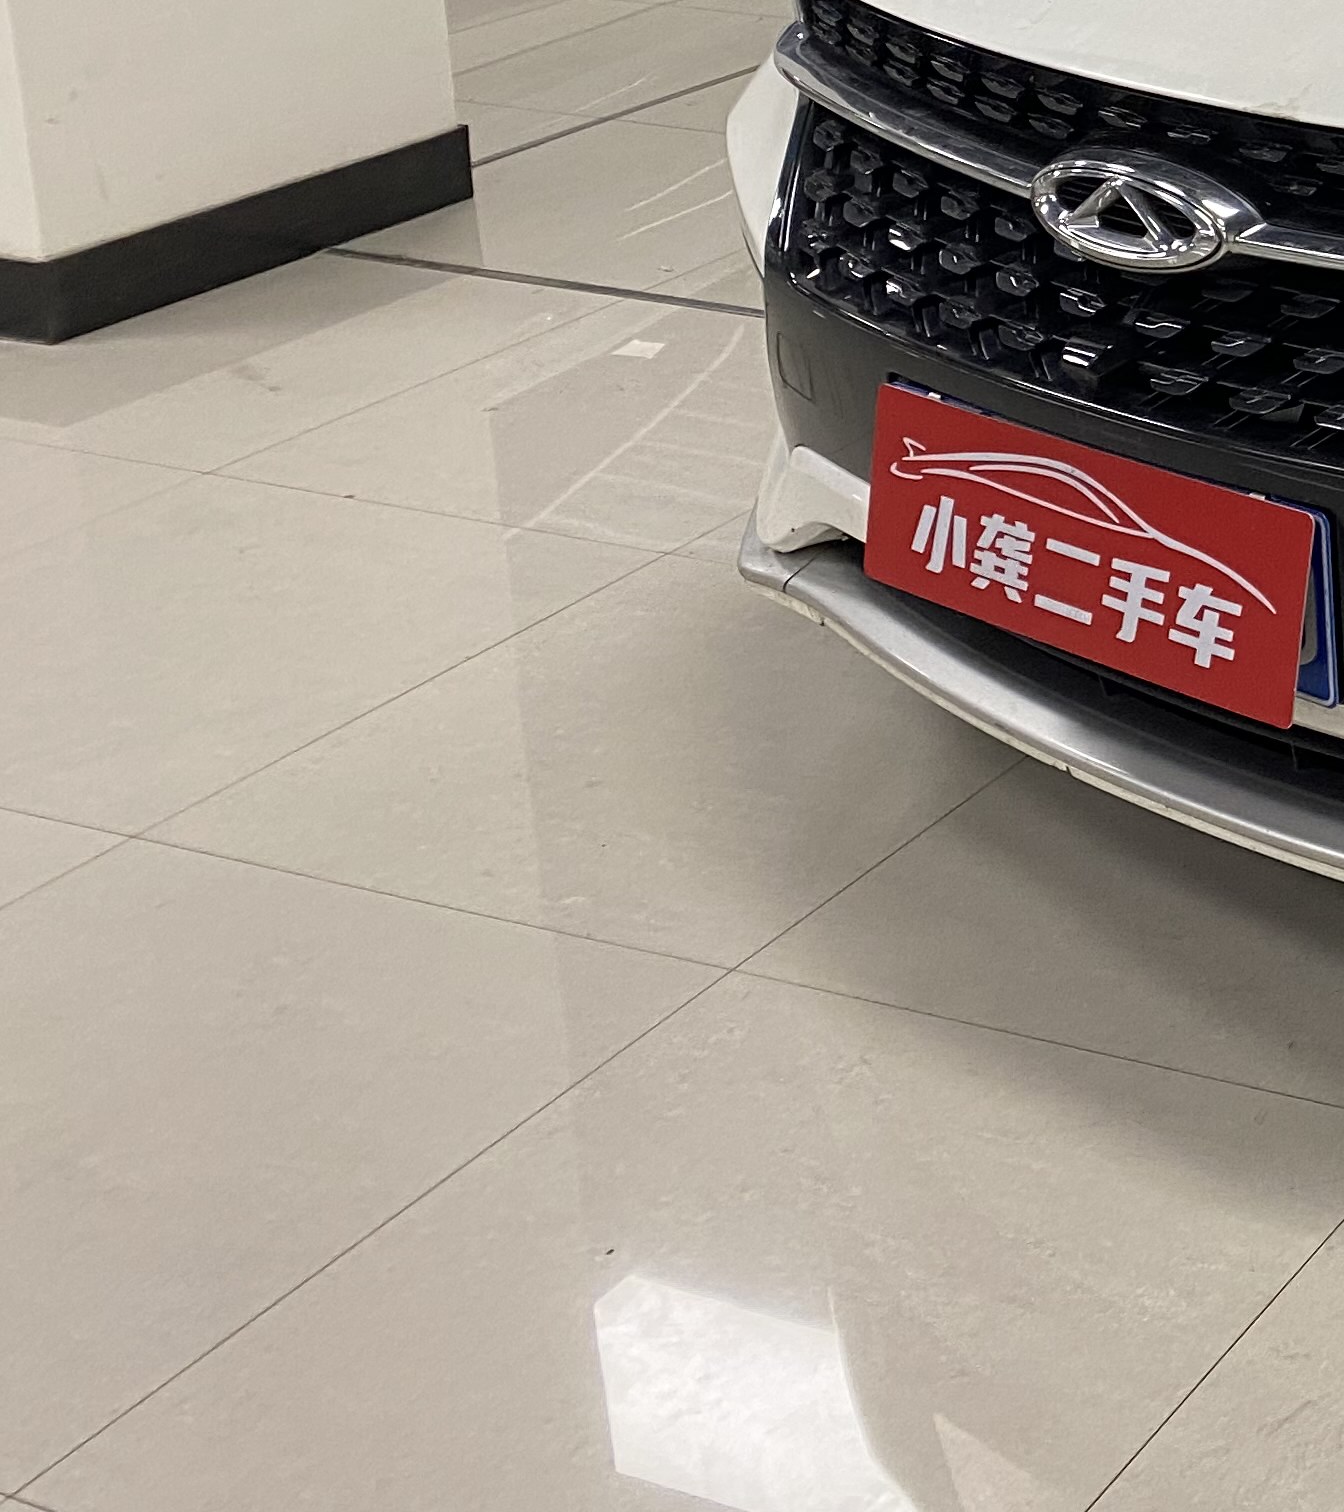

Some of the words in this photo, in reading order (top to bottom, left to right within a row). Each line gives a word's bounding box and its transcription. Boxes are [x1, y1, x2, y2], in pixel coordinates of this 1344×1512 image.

[910, 496, 1244, 670] 小龚二手车
